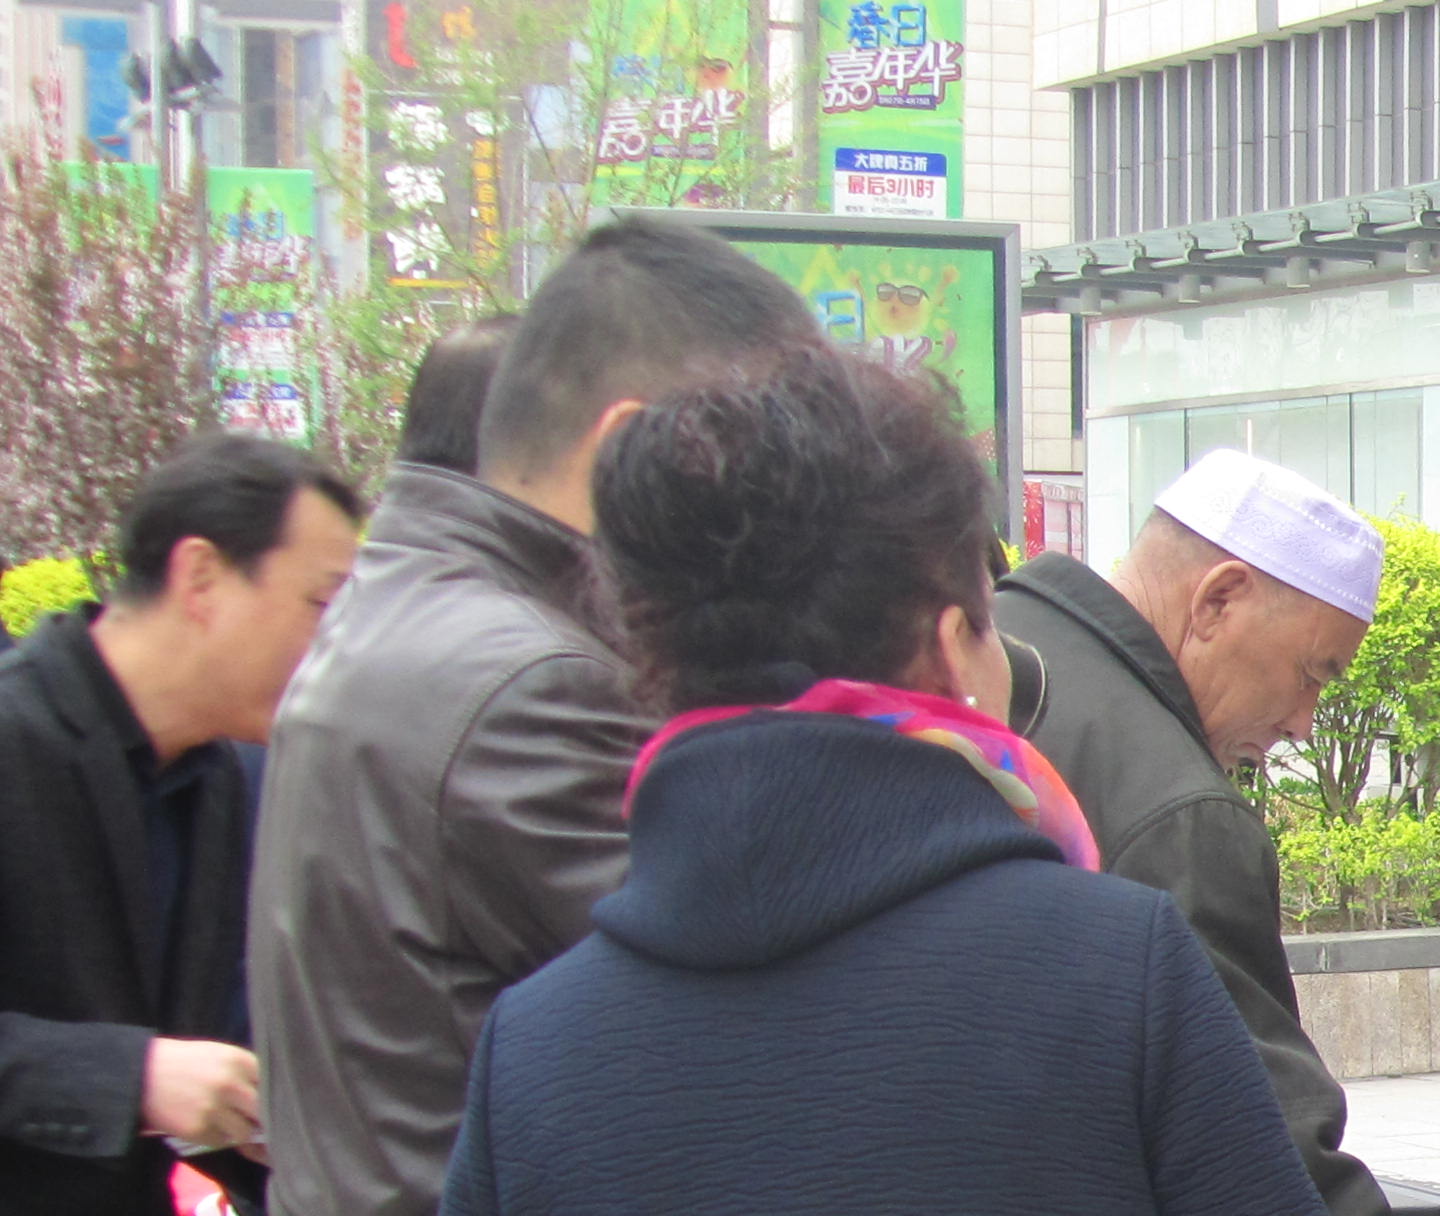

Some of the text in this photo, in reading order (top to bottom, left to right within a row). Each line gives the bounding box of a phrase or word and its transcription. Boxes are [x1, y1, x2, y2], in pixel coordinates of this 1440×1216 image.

[847, 1, 927, 48] 春日
[820, 40, 960, 108] 嘉年华
[848, 175, 934, 198] 最后3小时
